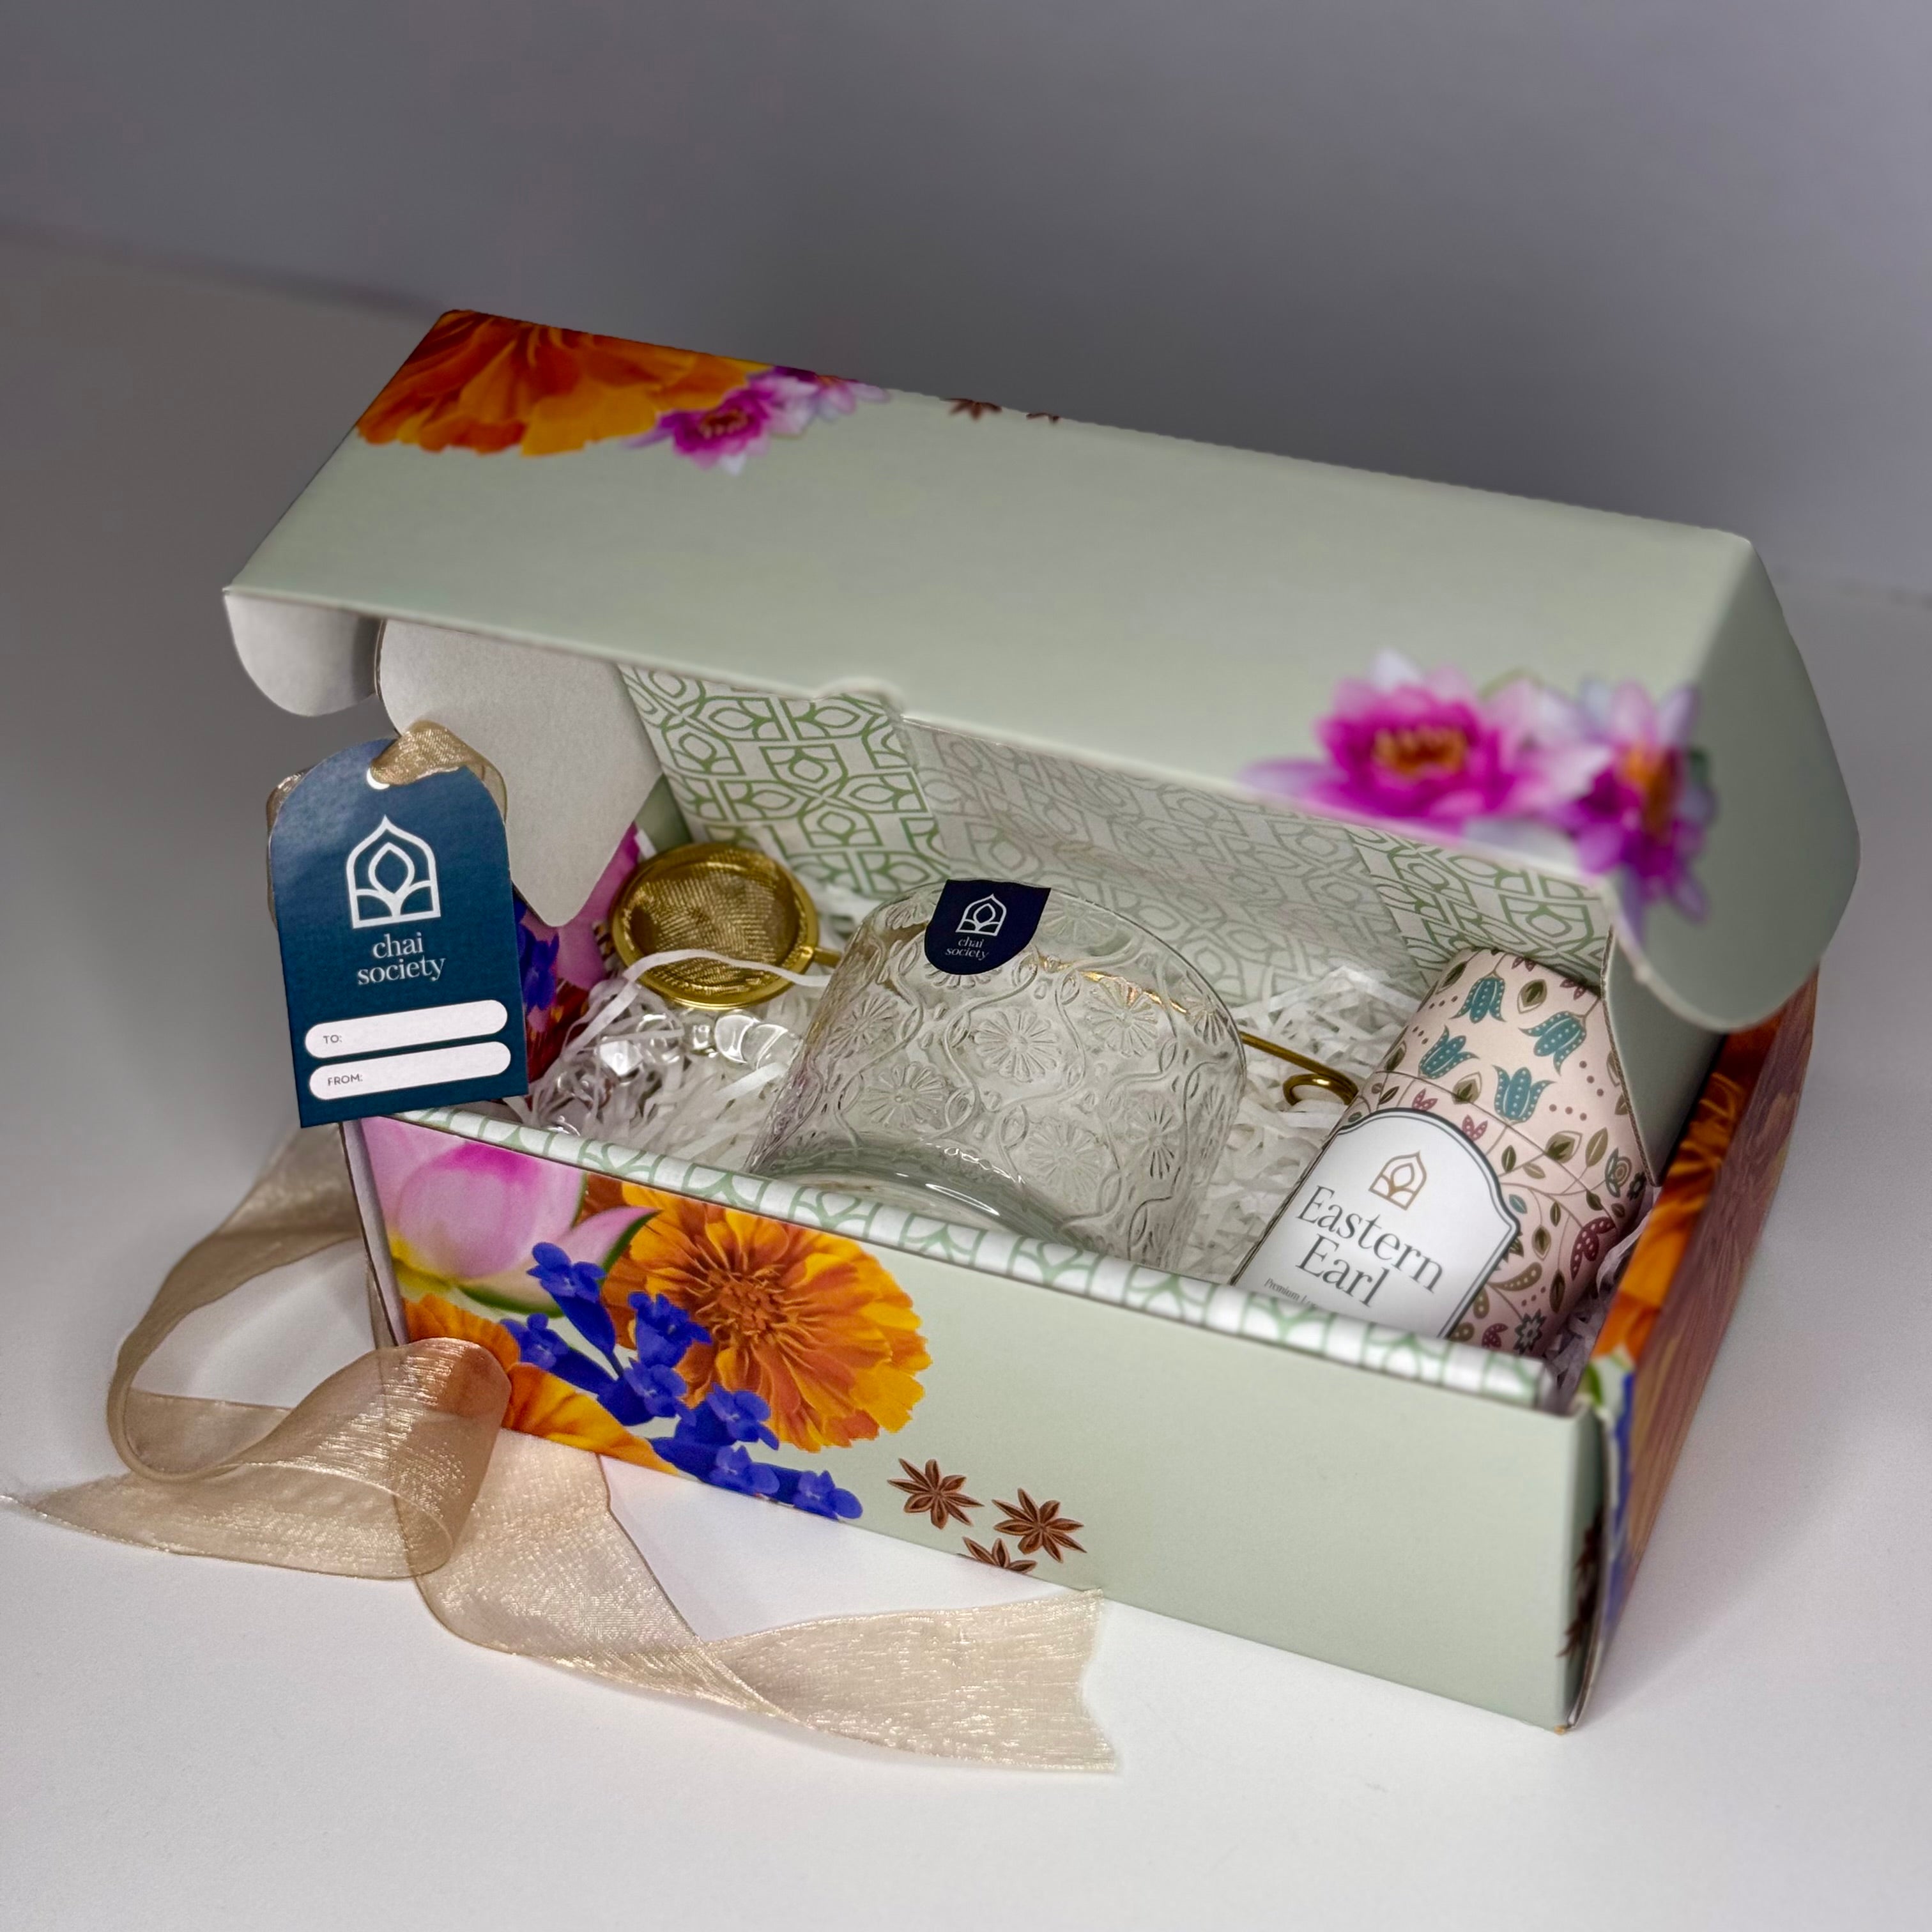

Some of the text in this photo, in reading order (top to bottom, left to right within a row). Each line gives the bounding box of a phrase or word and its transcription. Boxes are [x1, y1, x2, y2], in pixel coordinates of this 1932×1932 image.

[372, 931, 424, 958] chai
[945, 947, 990, 961] society
[958, 937, 985, 949] chai
[357, 955, 446, 985] society
[323, 1034, 342, 1044] TO:
[327, 1073, 363, 1086] FROM:
[1296, 1185, 1443, 1294] Eastern
[1295, 1233, 1390, 1308] Earl
[1264, 1277, 1301, 1301] Premium
